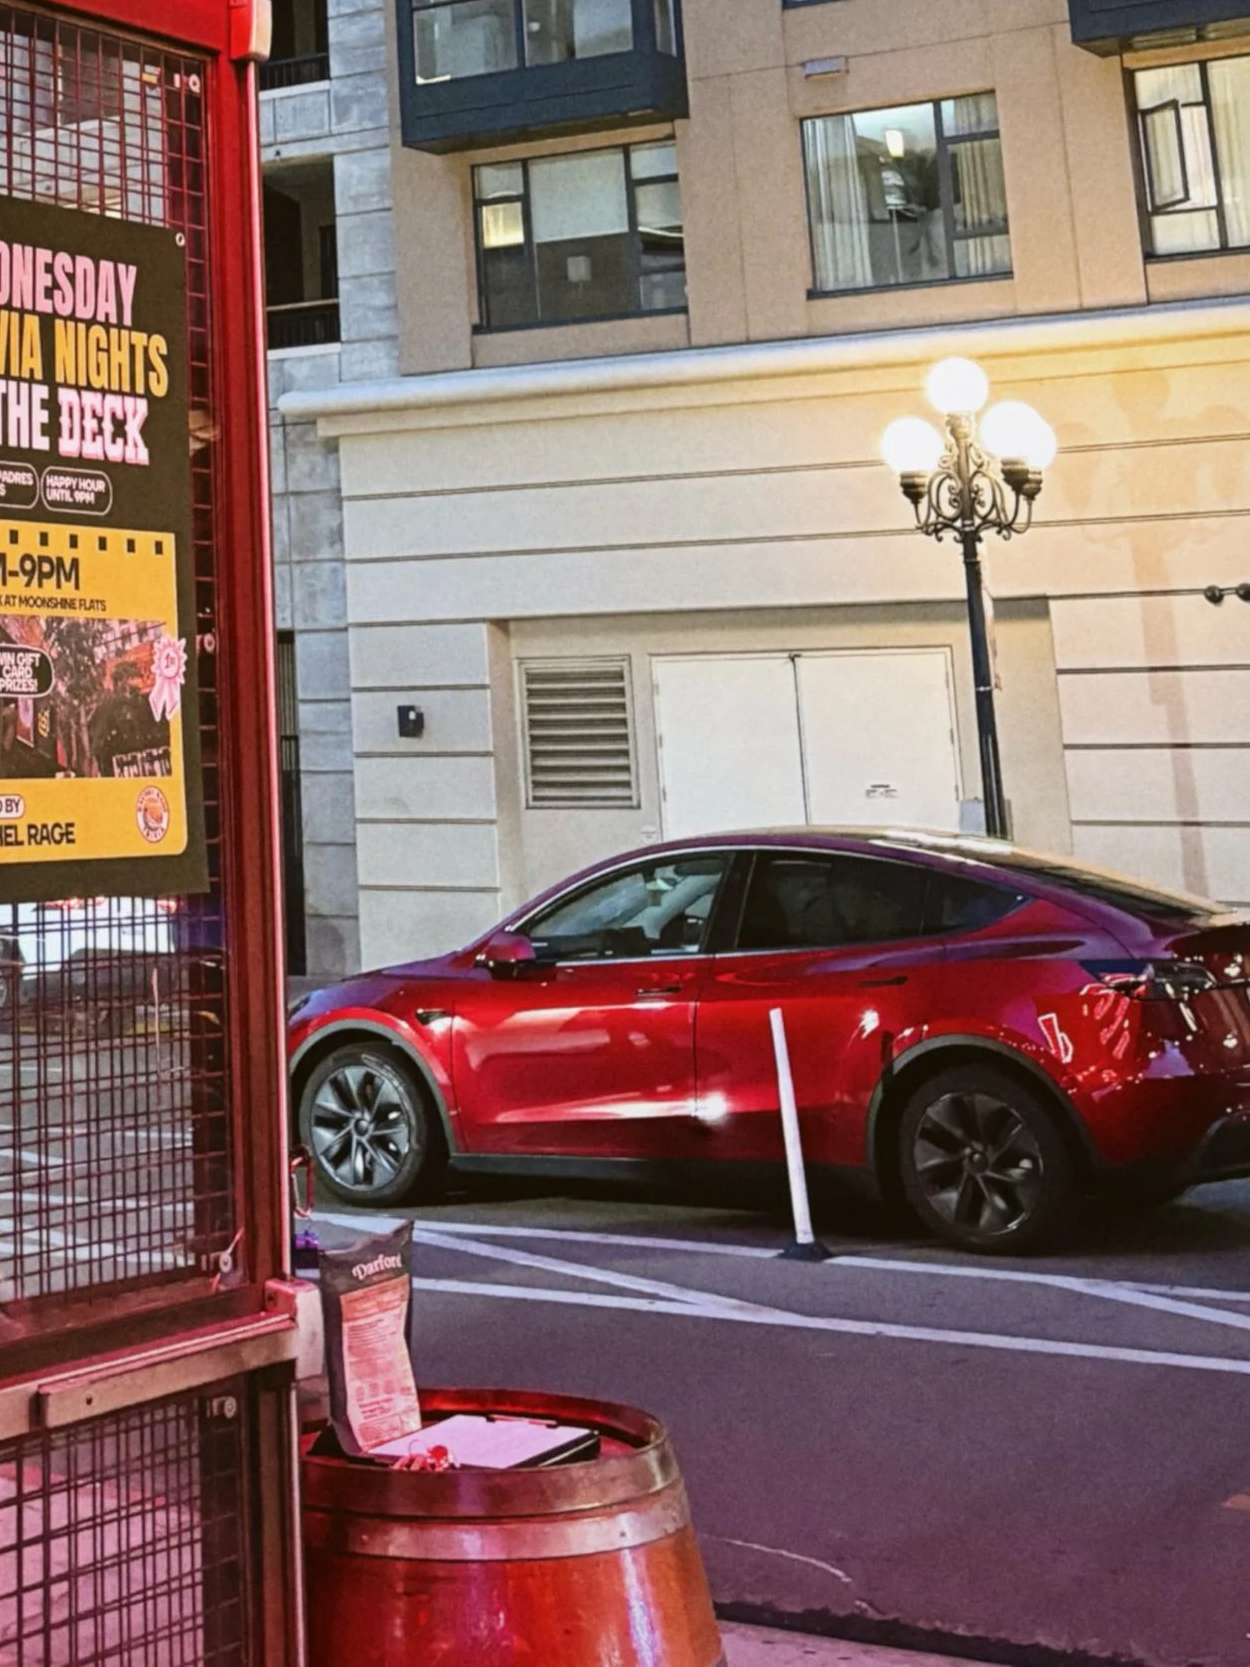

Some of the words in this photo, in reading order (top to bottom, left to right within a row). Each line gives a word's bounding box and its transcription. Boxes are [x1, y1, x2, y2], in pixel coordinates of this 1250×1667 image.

[54, 319, 168, 397] NIGHTS
[58, 387, 150, 466] DECK
[46, 475, 78, 489] HAPPY
[79, 478, 105, 492] HOUR
[46, 488, 73, 502] UNTIL
[74, 491, 95, 504] 9PM
[4, 595, 17, 607] AT
[19, 595, 77, 609] MOONSHINE
[79, 598, 107, 612] FLATS
[16, 652, 41, 667] GIFT
[2, 665, 33, 679] CARD
[5, 798, 21, 813] BY
[27, 822, 76, 846] RAGE
